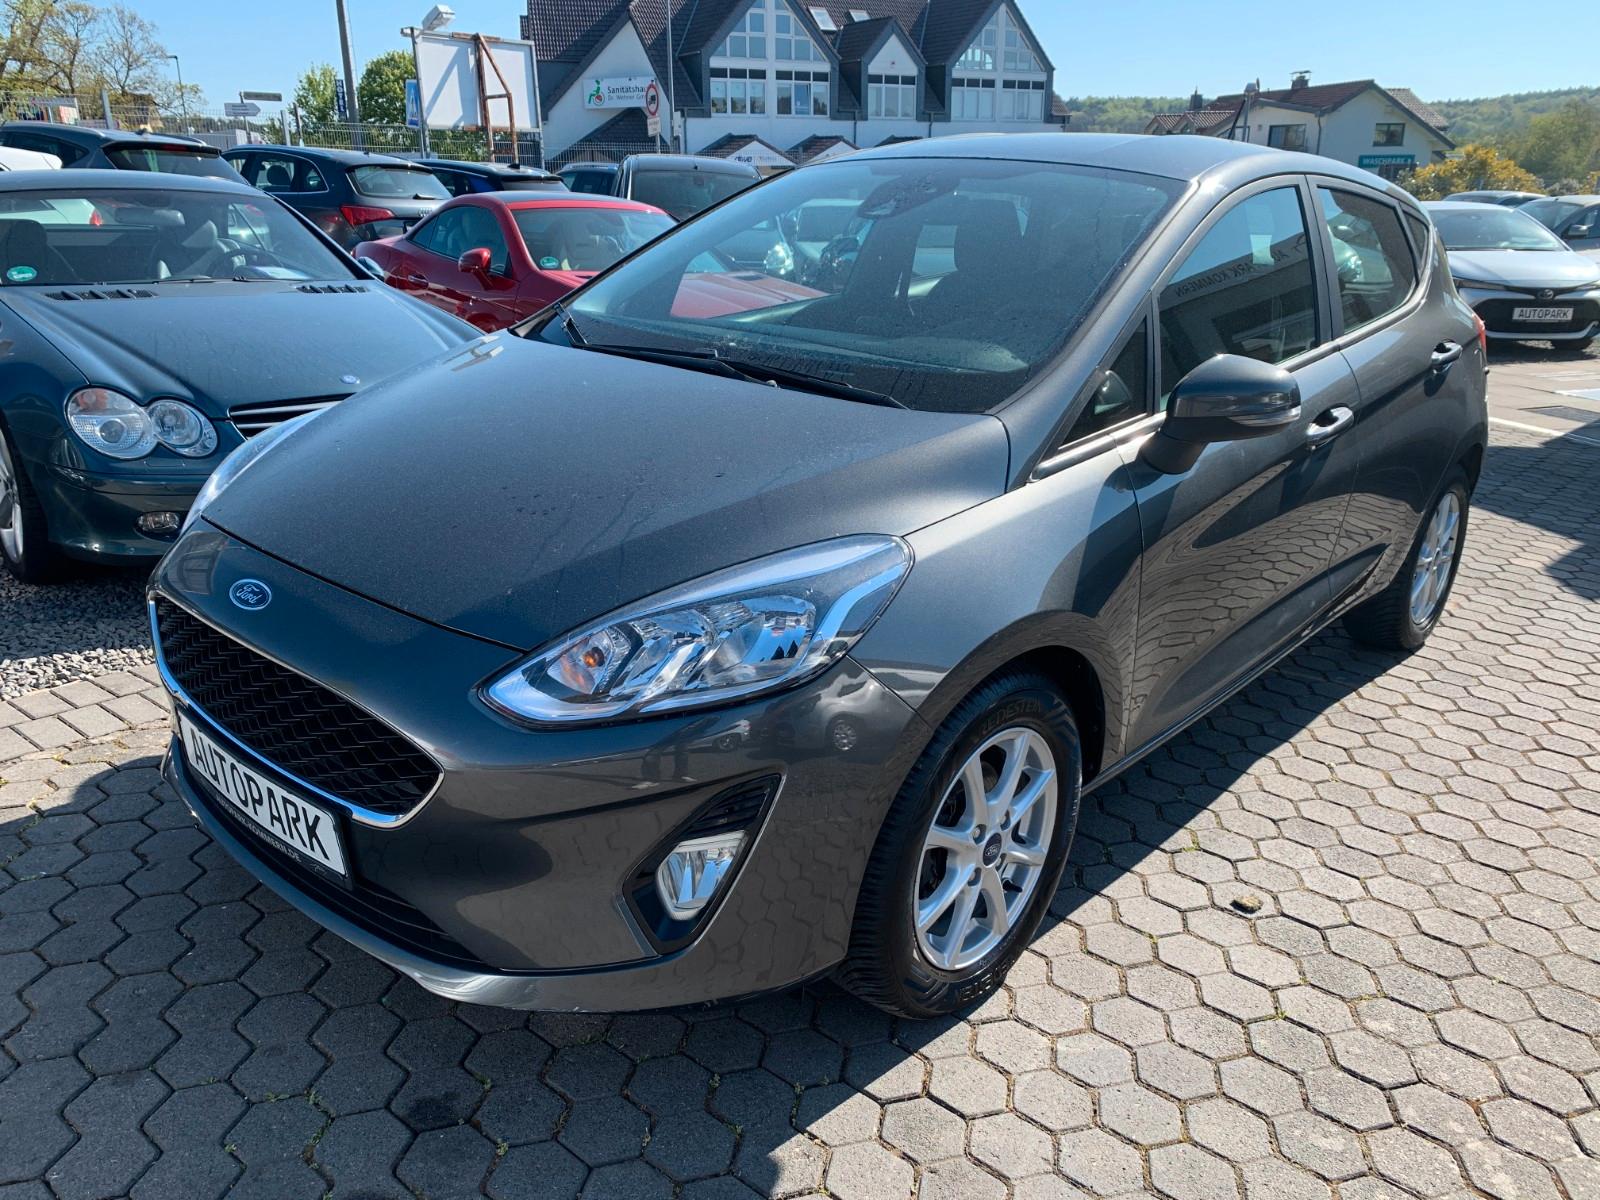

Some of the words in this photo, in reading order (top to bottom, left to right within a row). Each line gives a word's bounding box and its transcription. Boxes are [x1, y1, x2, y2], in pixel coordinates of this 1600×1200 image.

[335, 80, 346, 112] HOTEL
[607, 85, 647, 94] Sanitätsha
[1518, 309, 1569, 319] AUTOPARK
[190, 727, 330, 861] AUTOPARK
